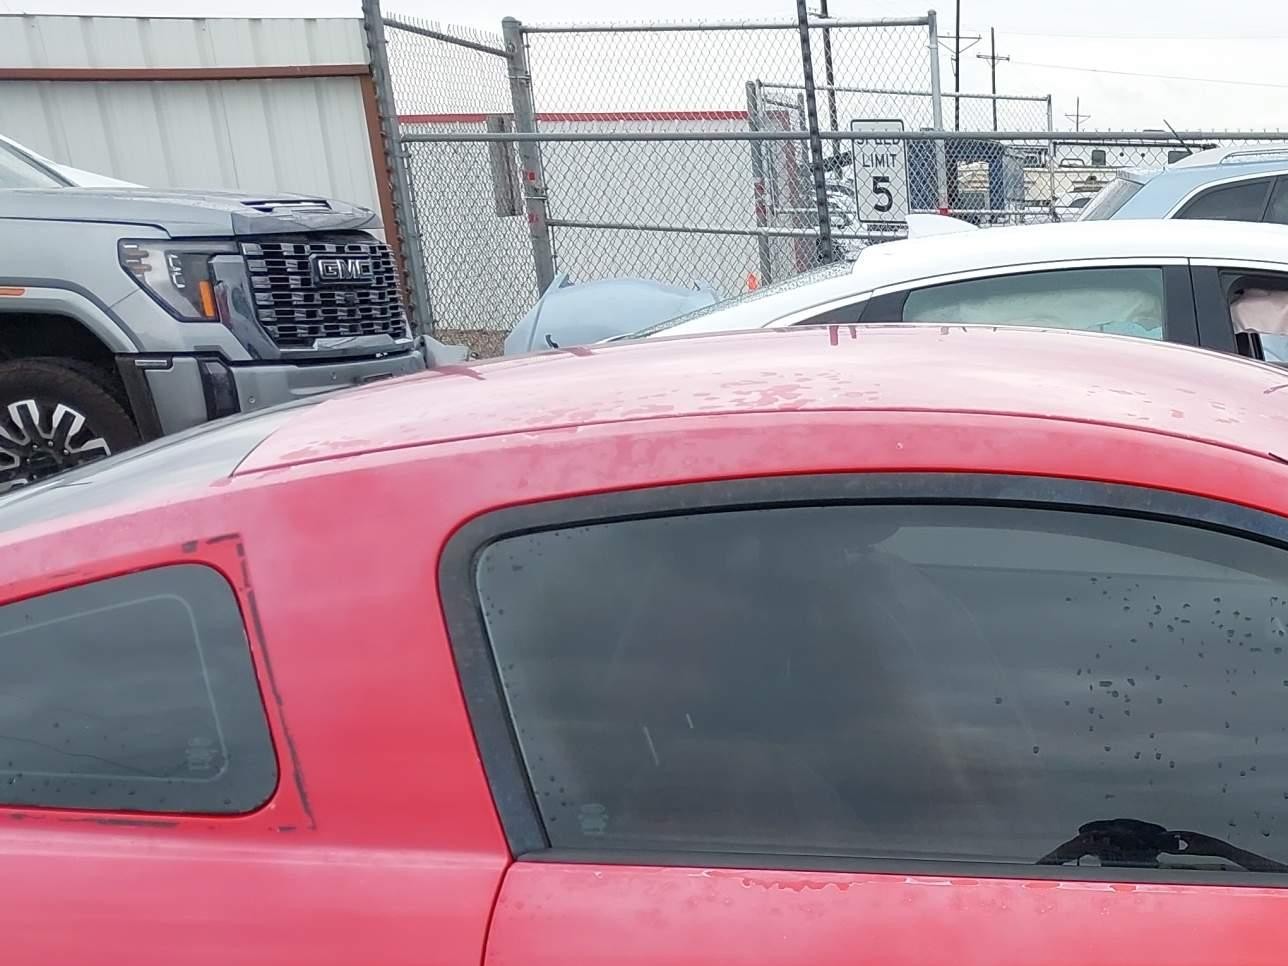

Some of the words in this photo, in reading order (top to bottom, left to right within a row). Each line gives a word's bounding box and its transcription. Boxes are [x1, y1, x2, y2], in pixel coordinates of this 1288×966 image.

[862, 153, 897, 168] LIMIT
[872, 175, 894, 213] 5
[318, 259, 373, 279] GMC
